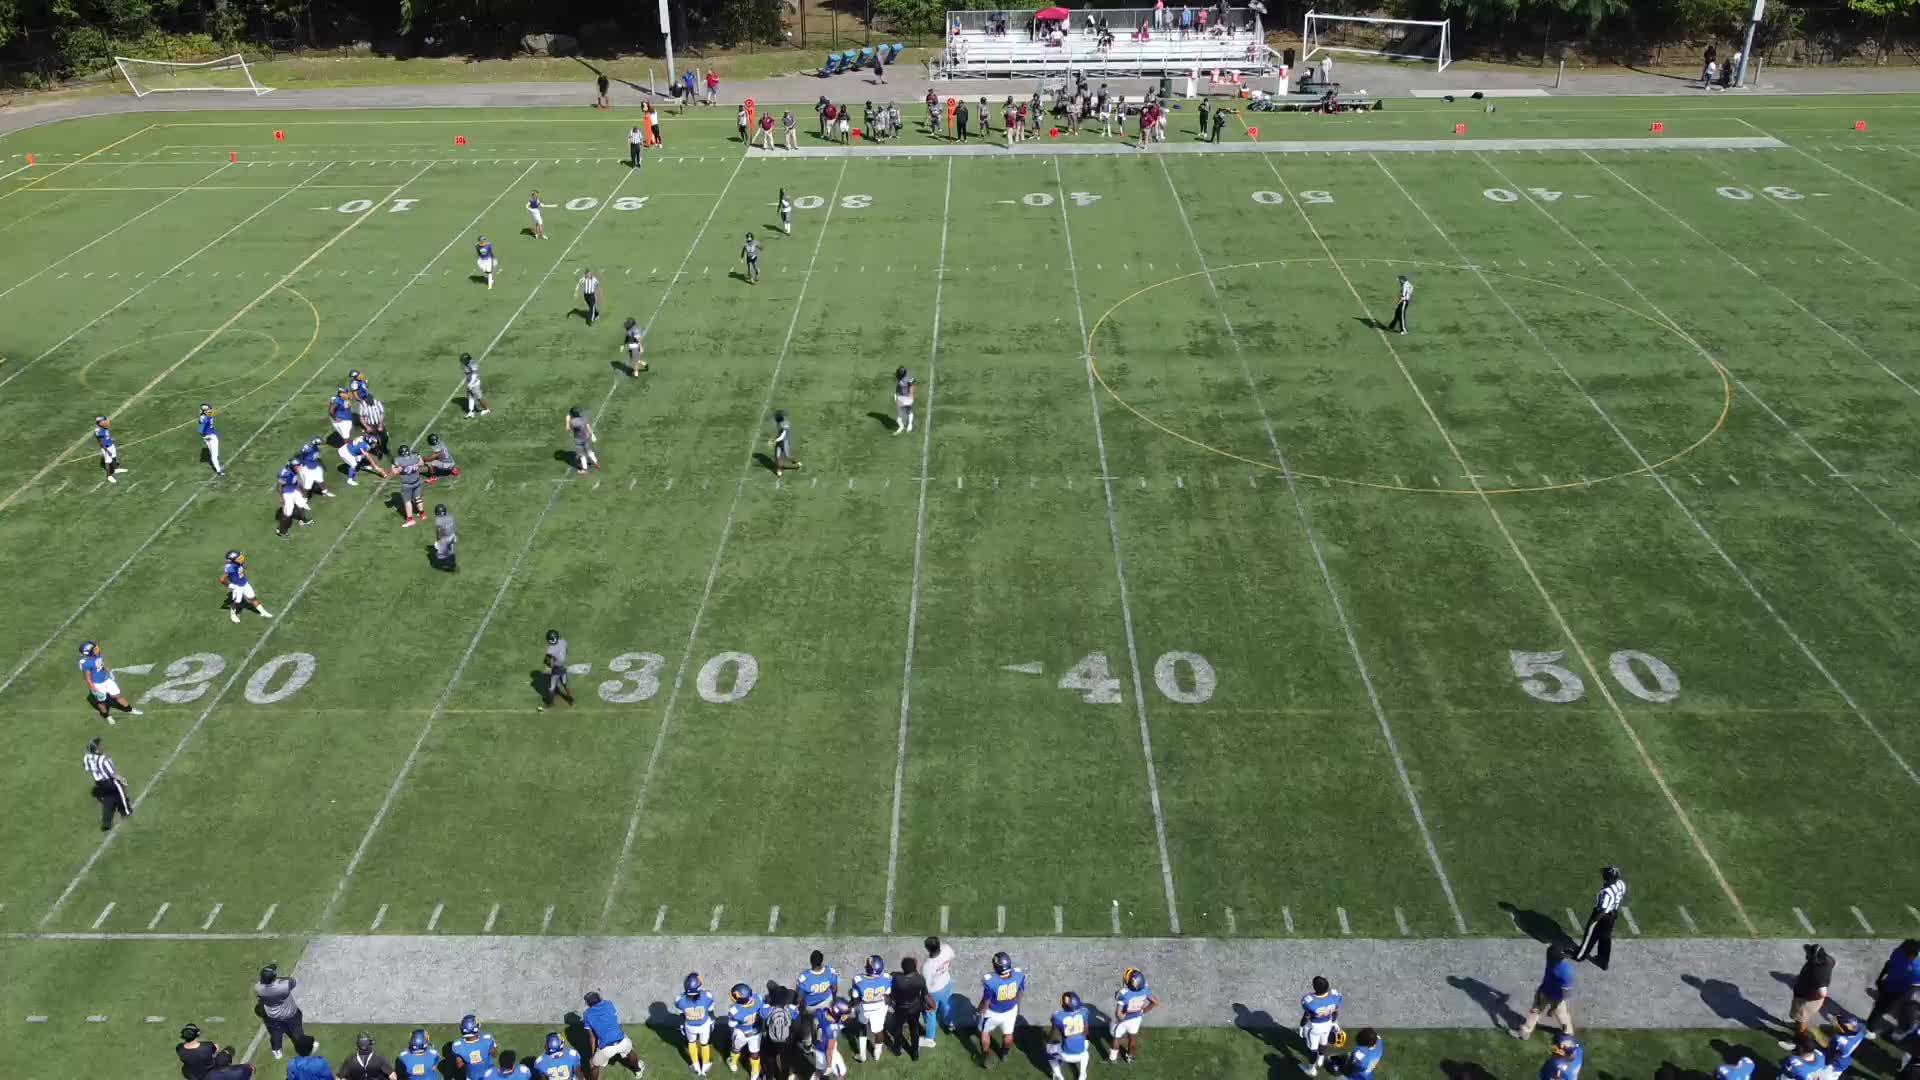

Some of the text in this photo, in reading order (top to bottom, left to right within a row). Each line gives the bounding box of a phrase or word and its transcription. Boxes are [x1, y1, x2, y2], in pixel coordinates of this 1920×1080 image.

[1023, 191, 1101, 207] 40
[1252, 190, 1334, 205] 50
[1484, 187, 1563, 203] 40
[1716, 186, 1804, 201] 30
[337, 199, 418, 213] 10
[566, 196, 649, 211] 20
[794, 195, 873, 209] 30
[136, 651, 317, 705] 20
[598, 651, 759, 704] 30
[1057, 650, 1217, 704] 40
[1508, 649, 1681, 704] 50
